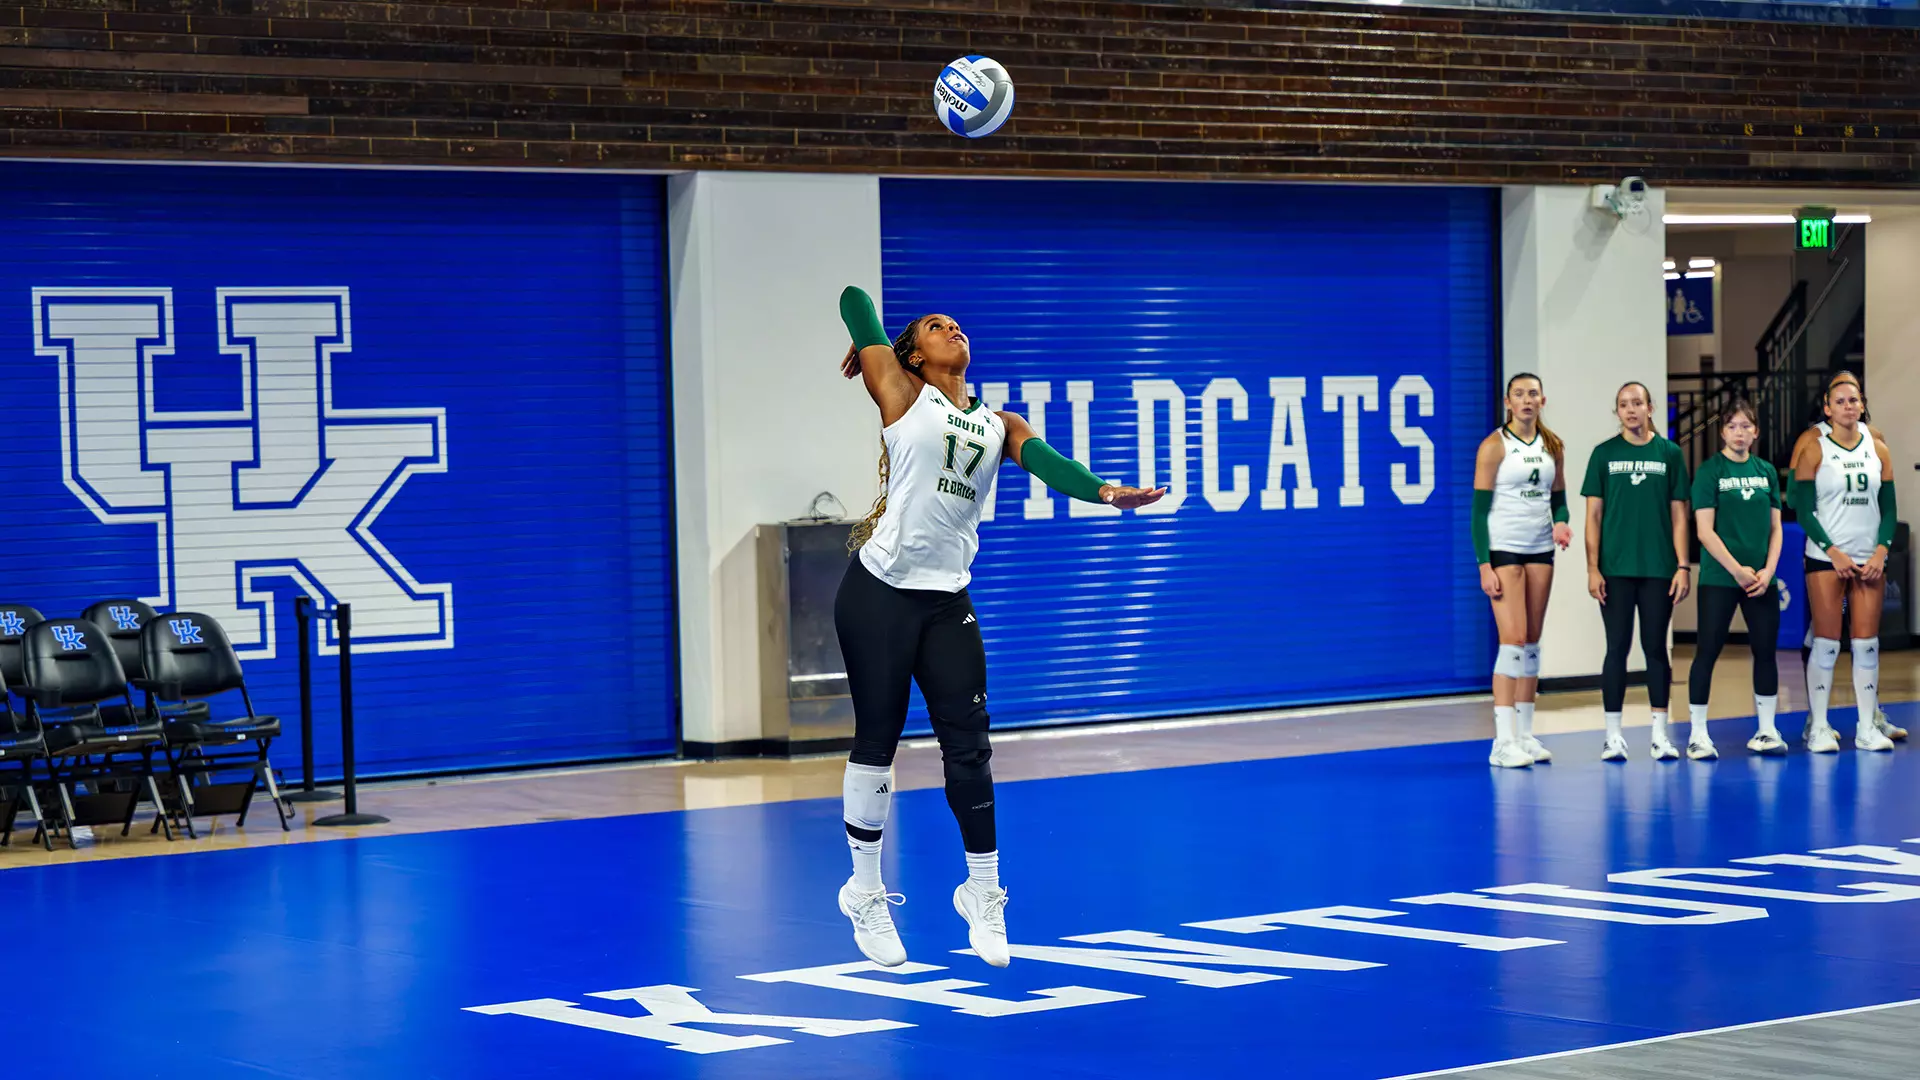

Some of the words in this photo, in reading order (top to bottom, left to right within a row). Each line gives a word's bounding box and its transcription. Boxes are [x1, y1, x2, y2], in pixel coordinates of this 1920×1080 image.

[936, 82, 968, 112] molten
[1801, 219, 1829, 248] EXIT
[947, 414, 984, 437] SOUTH
[942, 431, 987, 481] 17
[32, 286, 455, 662] UK
[1528, 468, 1541, 486] 4
[1844, 473, 1869, 493] 19
[937, 478, 976, 502] FLORIDA
[1842, 496, 1869, 506] FLORIDA
[108, 605, 141, 630] UK
[50, 624, 87, 651] UK
[169, 619, 204, 645] UK
[461, 838, 1920, 1055] KENTUCK
